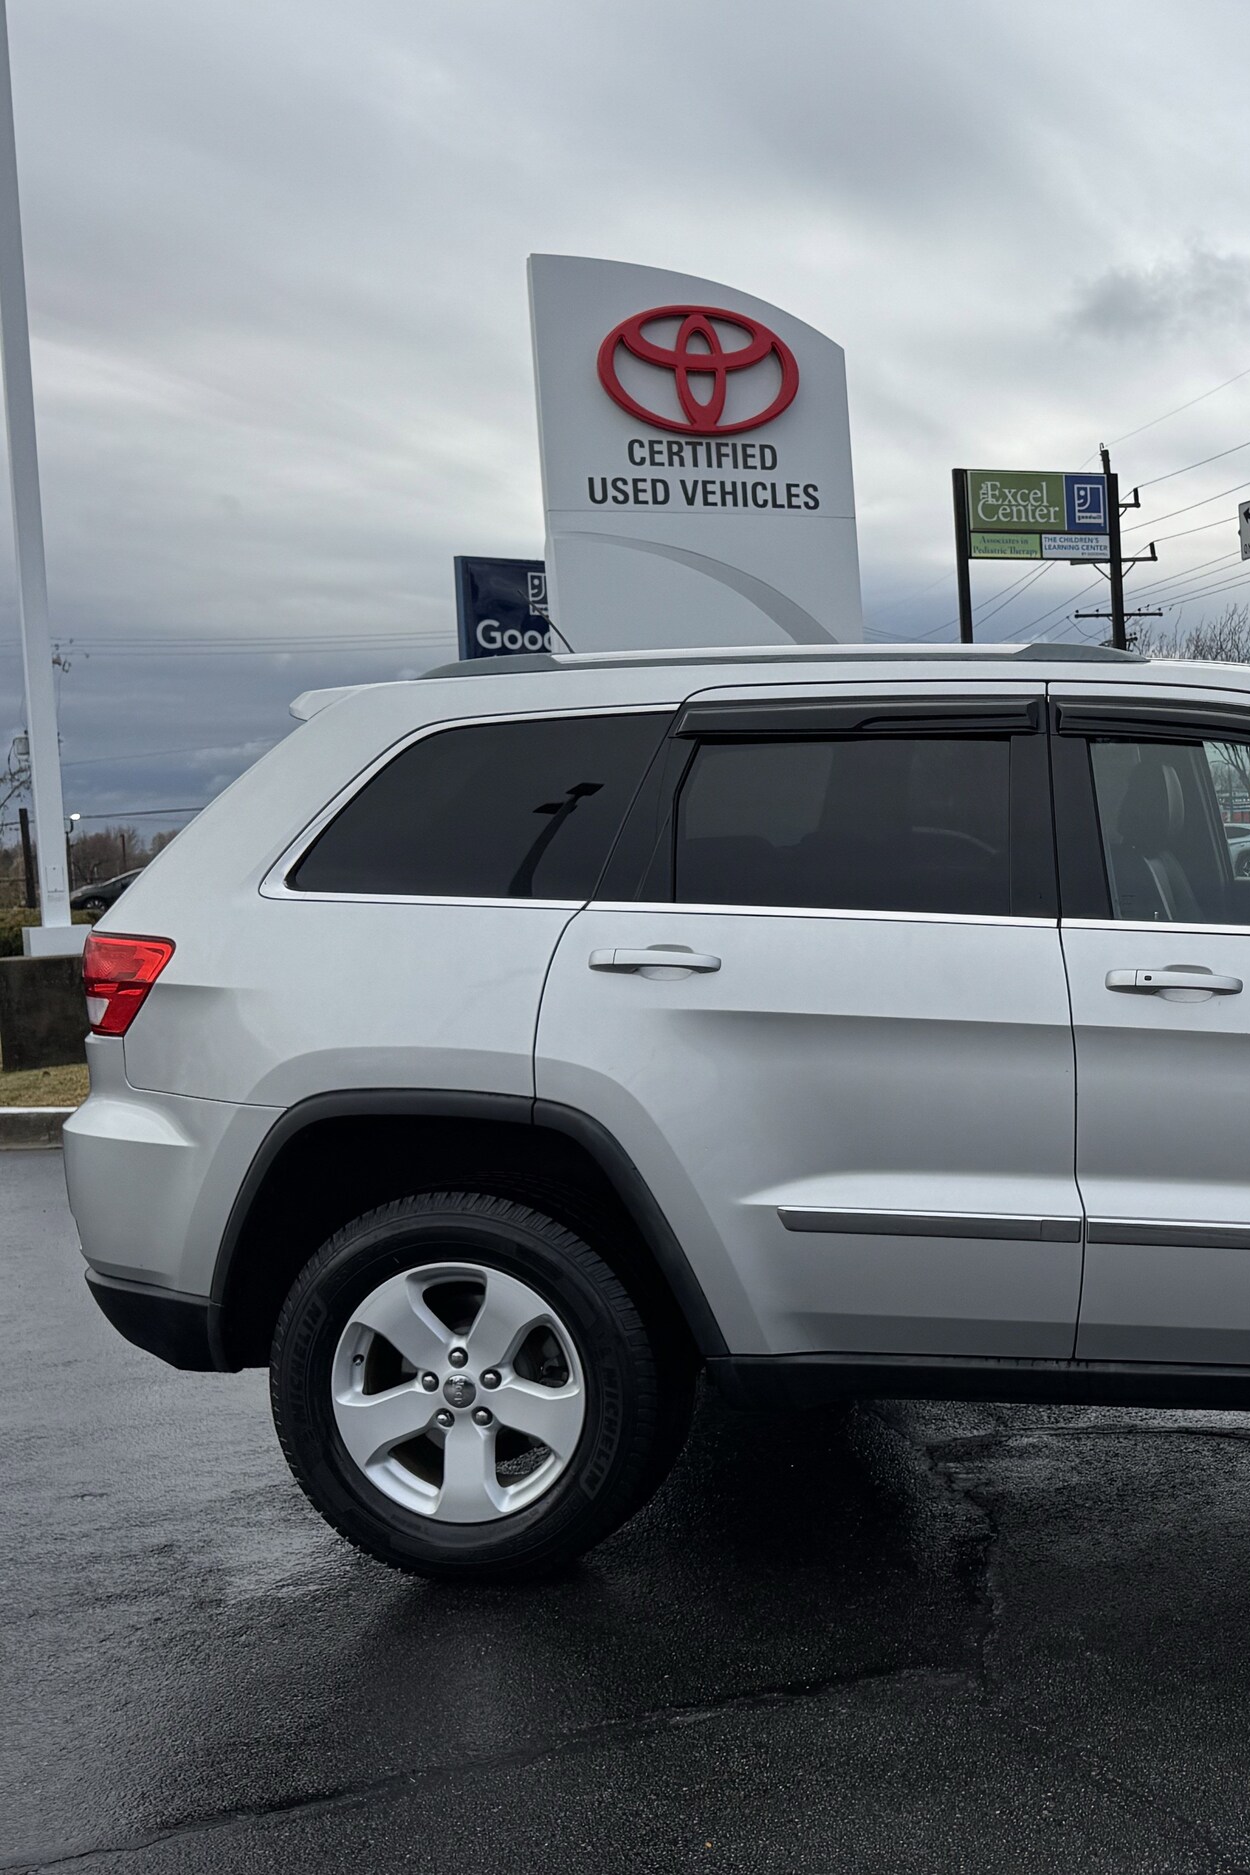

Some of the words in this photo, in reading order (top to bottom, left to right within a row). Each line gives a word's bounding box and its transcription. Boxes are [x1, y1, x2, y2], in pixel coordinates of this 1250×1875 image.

[627, 438, 778, 471] CERTIFIED
[587, 476, 670, 506] USED
[679, 478, 821, 511] VEHICLES
[985, 481, 1049, 506] Excel
[978, 498, 1060, 523] Center
[973, 545, 1008, 555] Pediatric
[1008, 546, 1038, 557] Therapy
[981, 536, 1019, 544] Associates
